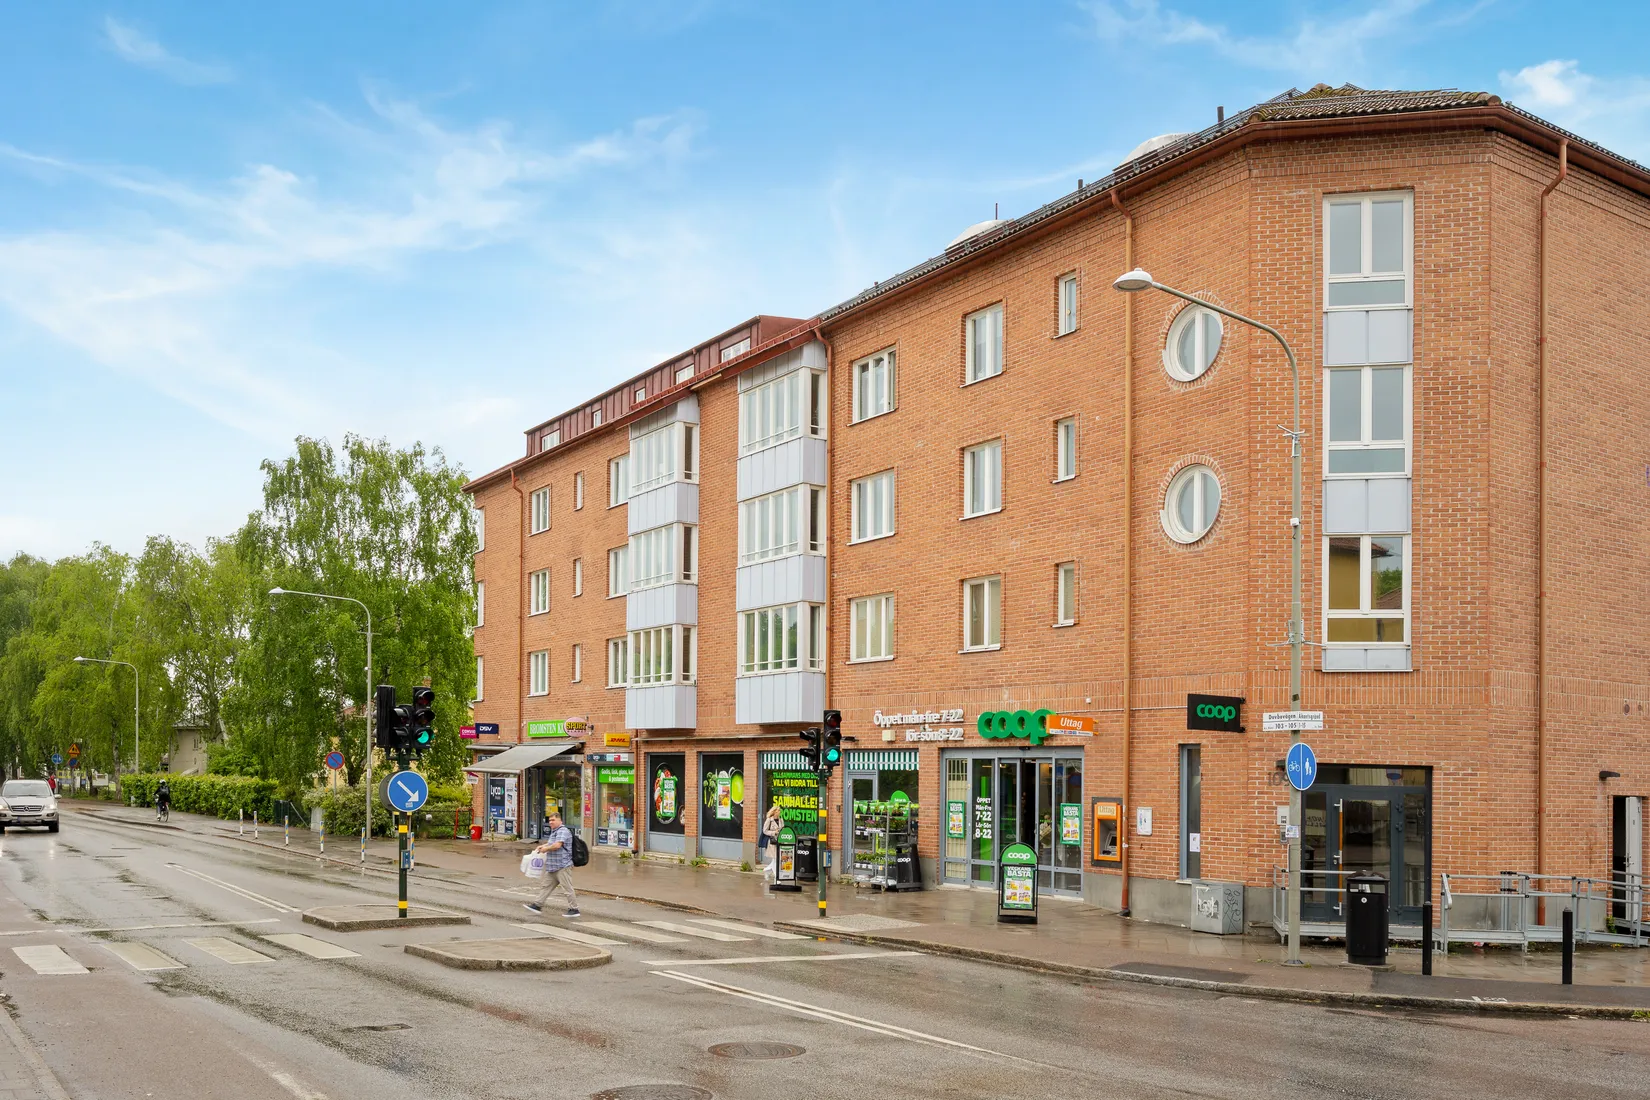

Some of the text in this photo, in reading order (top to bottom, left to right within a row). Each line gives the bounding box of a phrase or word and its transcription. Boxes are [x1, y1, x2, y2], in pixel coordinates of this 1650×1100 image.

[873, 710, 902, 727] Öppet
[1196, 703, 1236, 723] coop
[565, 721, 587, 731] SPORT
[977, 708, 1057, 745] coop
[1060, 717, 1083, 730] Uttag
[773, 779, 818, 788] VILL VI BIDRA TILL
[778, 808, 817, 822] ROMSTEN
[1099, 805, 1115, 815] Uttag
[1008, 852, 1031, 861] coop
